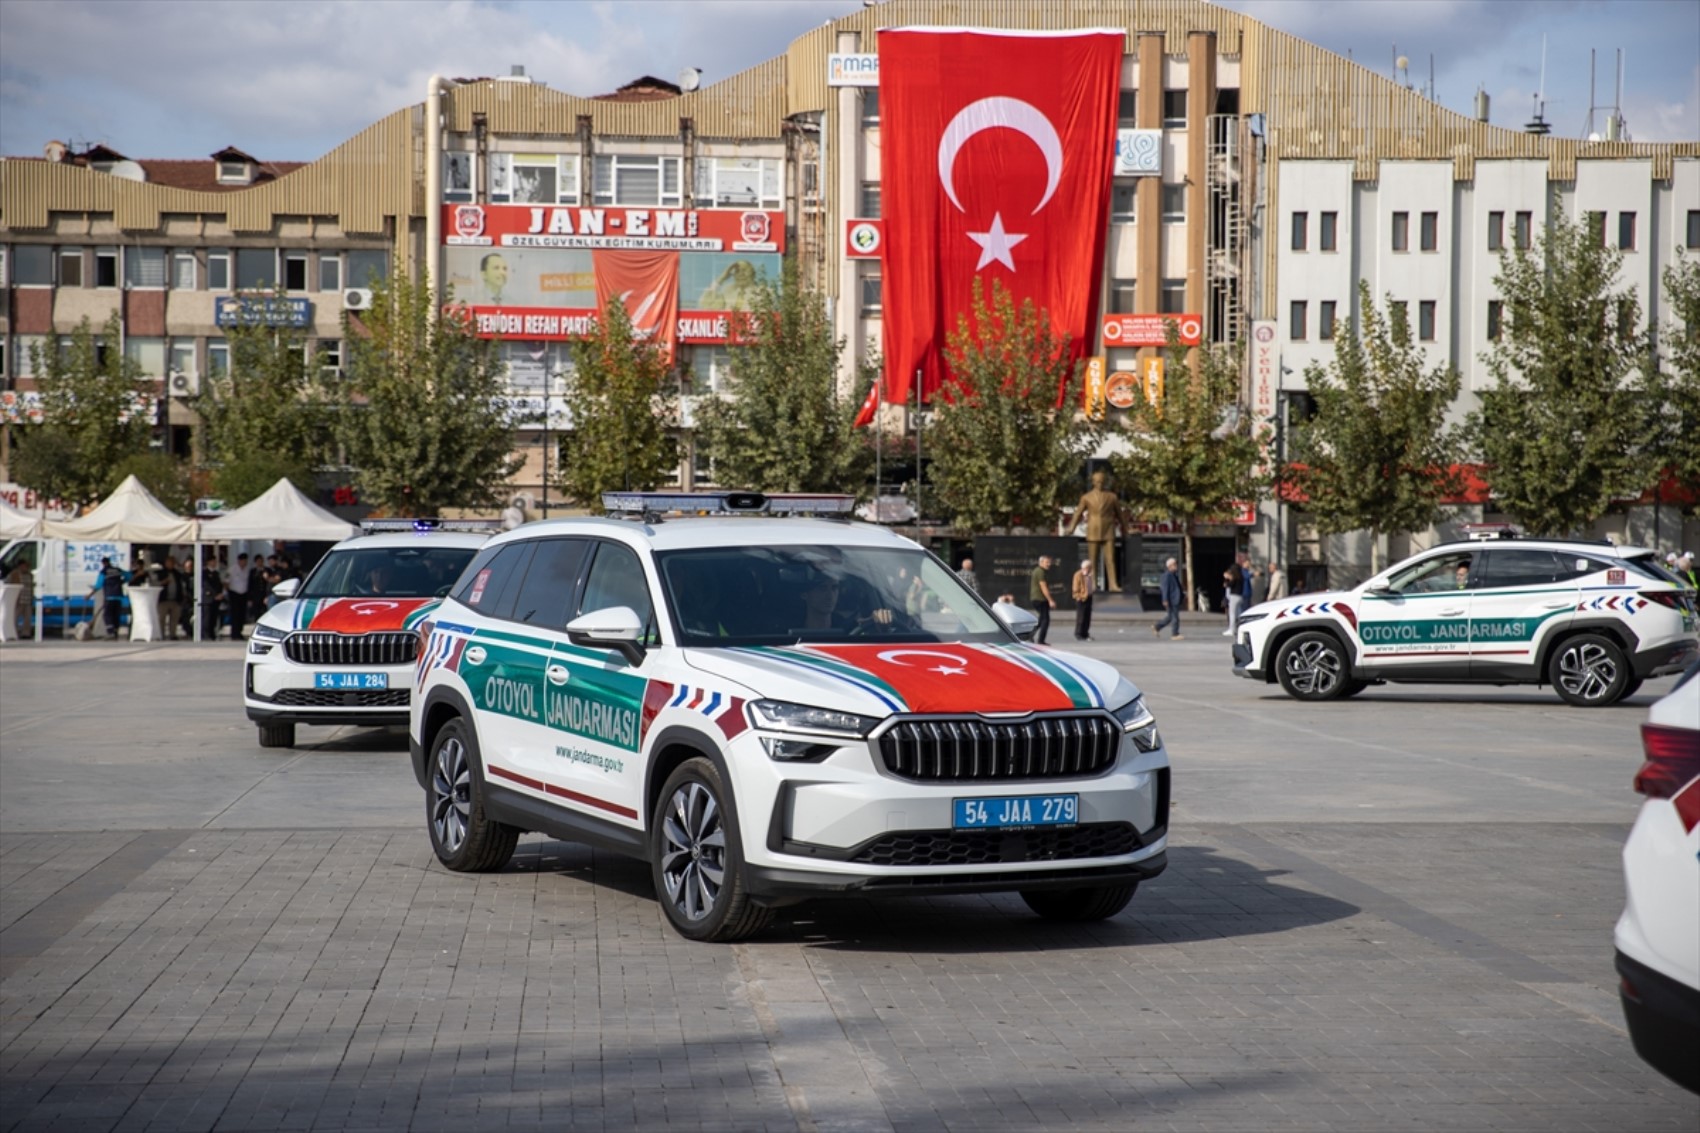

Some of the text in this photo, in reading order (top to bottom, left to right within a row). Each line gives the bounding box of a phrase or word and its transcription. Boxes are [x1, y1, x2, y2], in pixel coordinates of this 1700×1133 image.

[528, 207, 686, 237] JAN-EM
[511, 236, 541, 246] ÖZEL
[647, 240, 716, 250] KURUMLARI
[476, 310, 522, 333] YENİDEN
[525, 314, 559, 334] REFAH
[1362, 622, 1527, 641] OTOYOL JANDARMASI
[1375, 643, 1456, 653] www.jandarma.gov.tr
[320, 673, 384, 687] 54 JAA 284
[485, 676, 636, 747] OTOYOL JANDARMASI
[555, 744, 624, 773] www.jandarma.gov.tr
[965, 797, 1075, 824] 54 JAA 279
